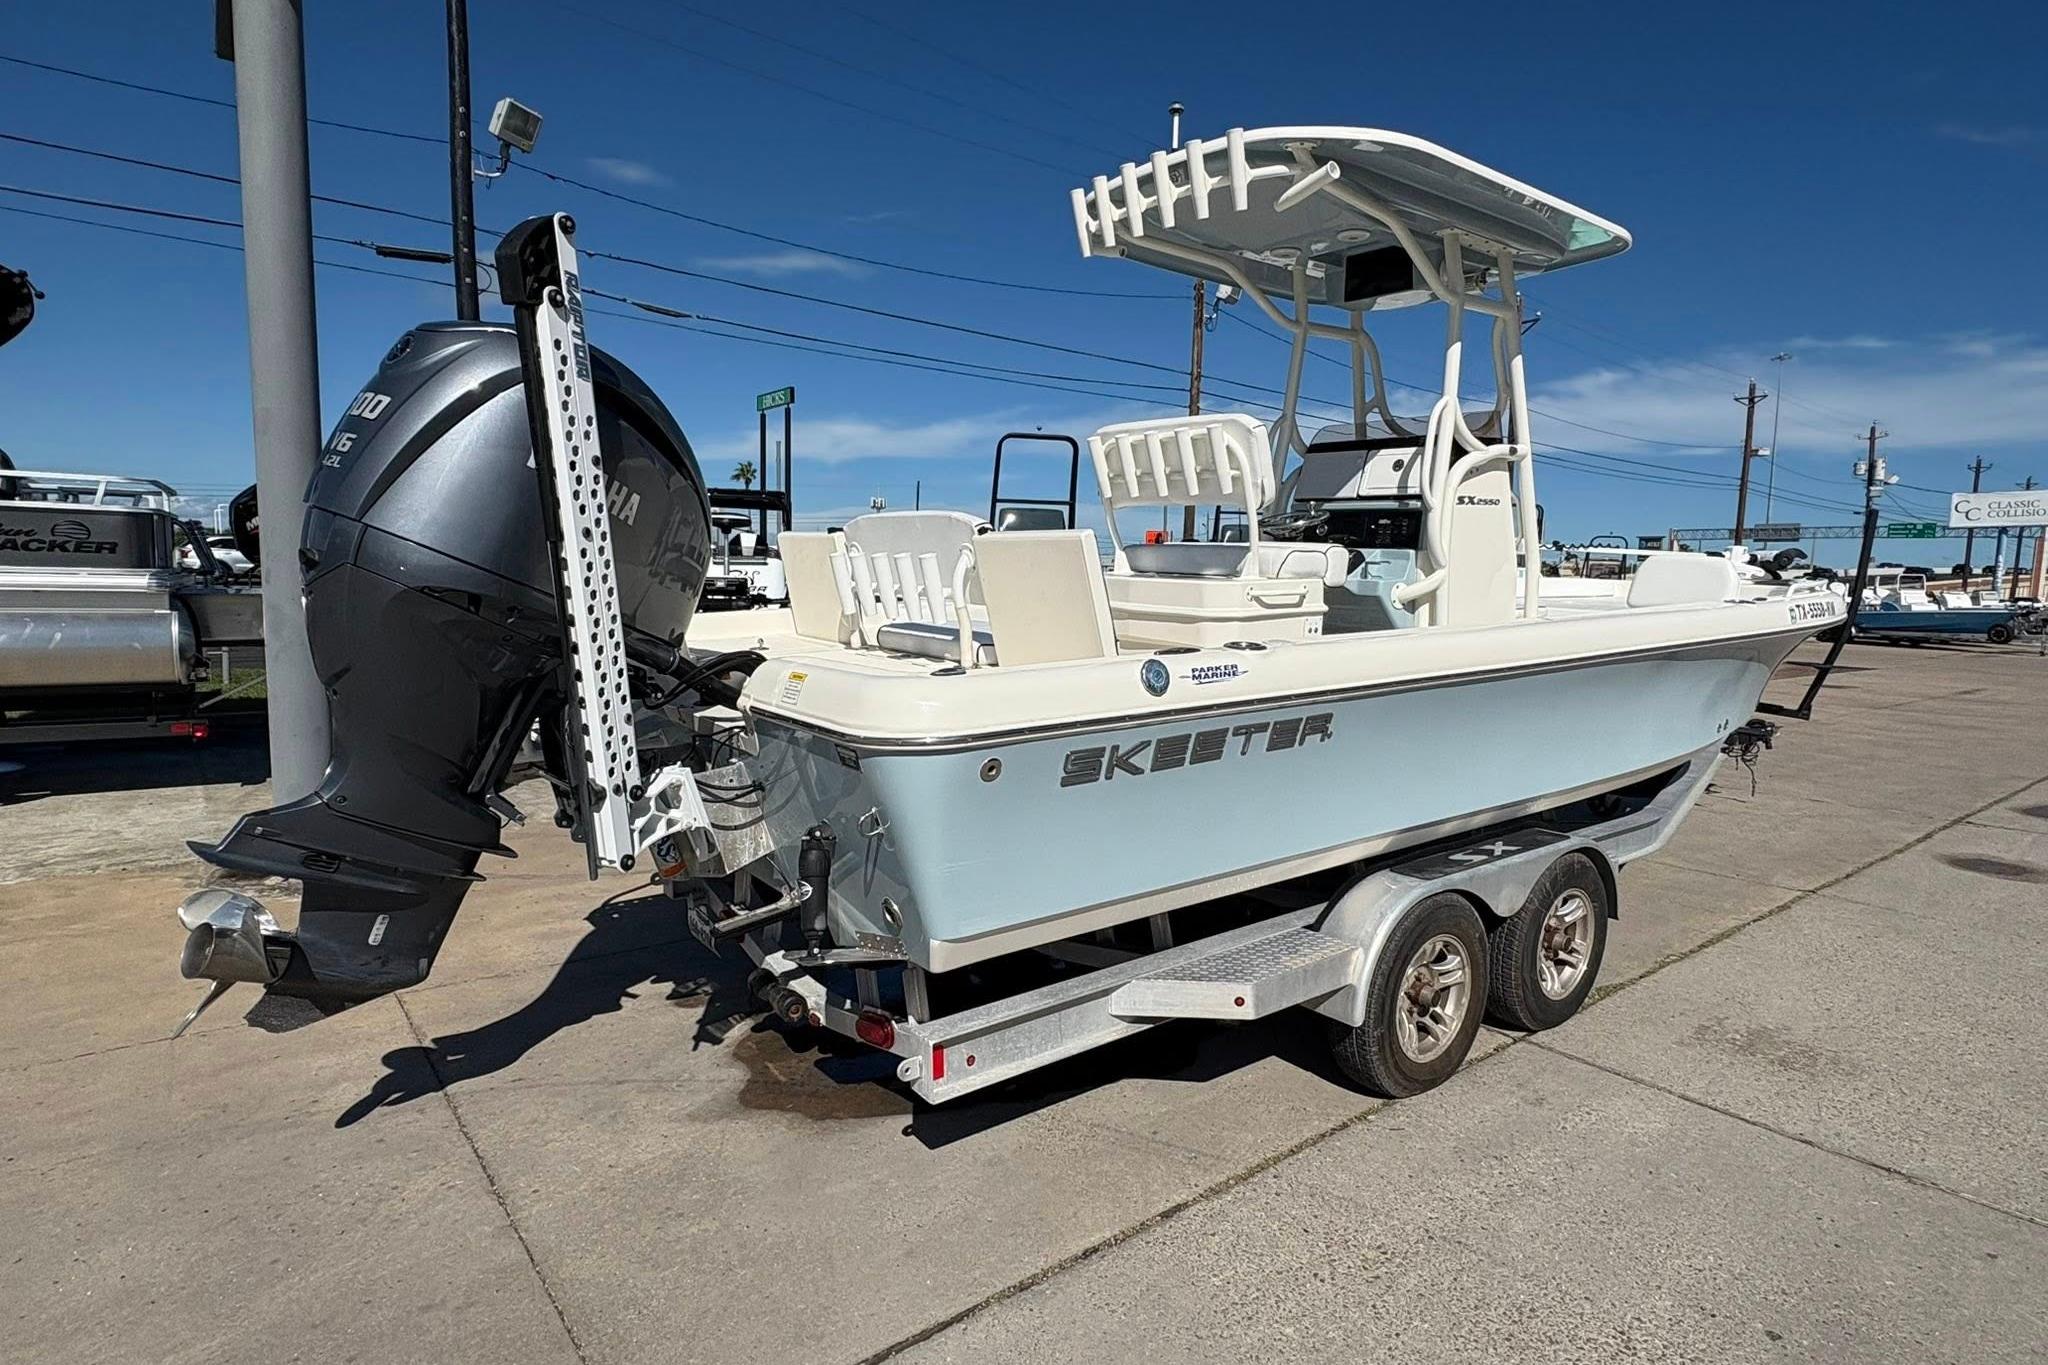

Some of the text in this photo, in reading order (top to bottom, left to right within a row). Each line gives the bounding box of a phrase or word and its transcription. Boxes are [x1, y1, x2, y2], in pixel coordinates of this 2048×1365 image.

[564, 270, 591, 382] RAPTOR
[347, 391, 392, 420] 00
[1456, 496, 1501, 506] SX2550
[1987, 500, 2041, 510] CLASSIC
[1986, 508, 2048, 519] COLLISIO
[1191, 664, 1239, 674] PARKER
[1191, 670, 1240, 681] MARINE
[1060, 712, 1334, 788] SKEETER
[1448, 841, 1523, 866] SX
